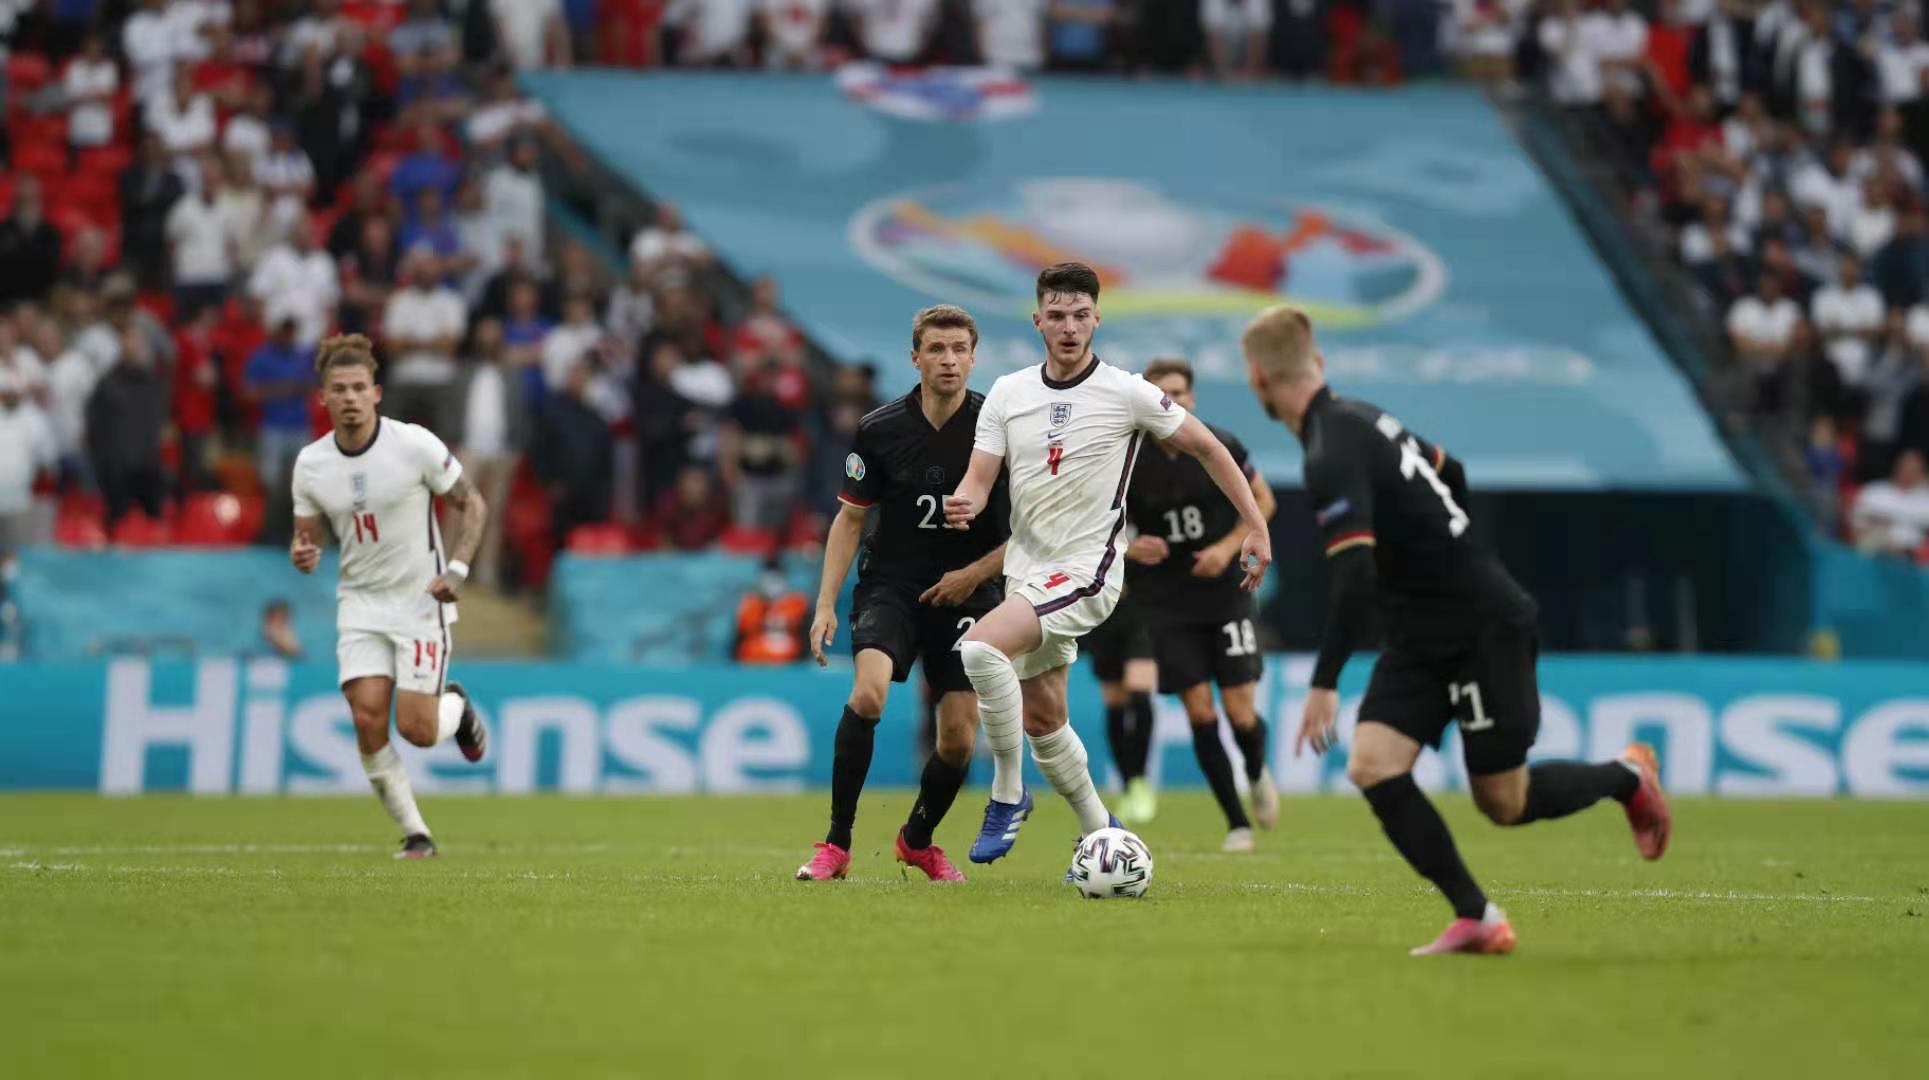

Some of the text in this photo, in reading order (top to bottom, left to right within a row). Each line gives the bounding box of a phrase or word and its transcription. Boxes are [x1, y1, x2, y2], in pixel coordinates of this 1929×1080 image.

[1047, 448, 1063, 475] 4
[353, 512, 378, 544] 14
[1164, 506, 1204, 541] 18
[1043, 572, 1069, 589] 4
[951, 617, 975, 652] 2
[1222, 618, 1257, 656] 18
[414, 639, 436, 671] 14
